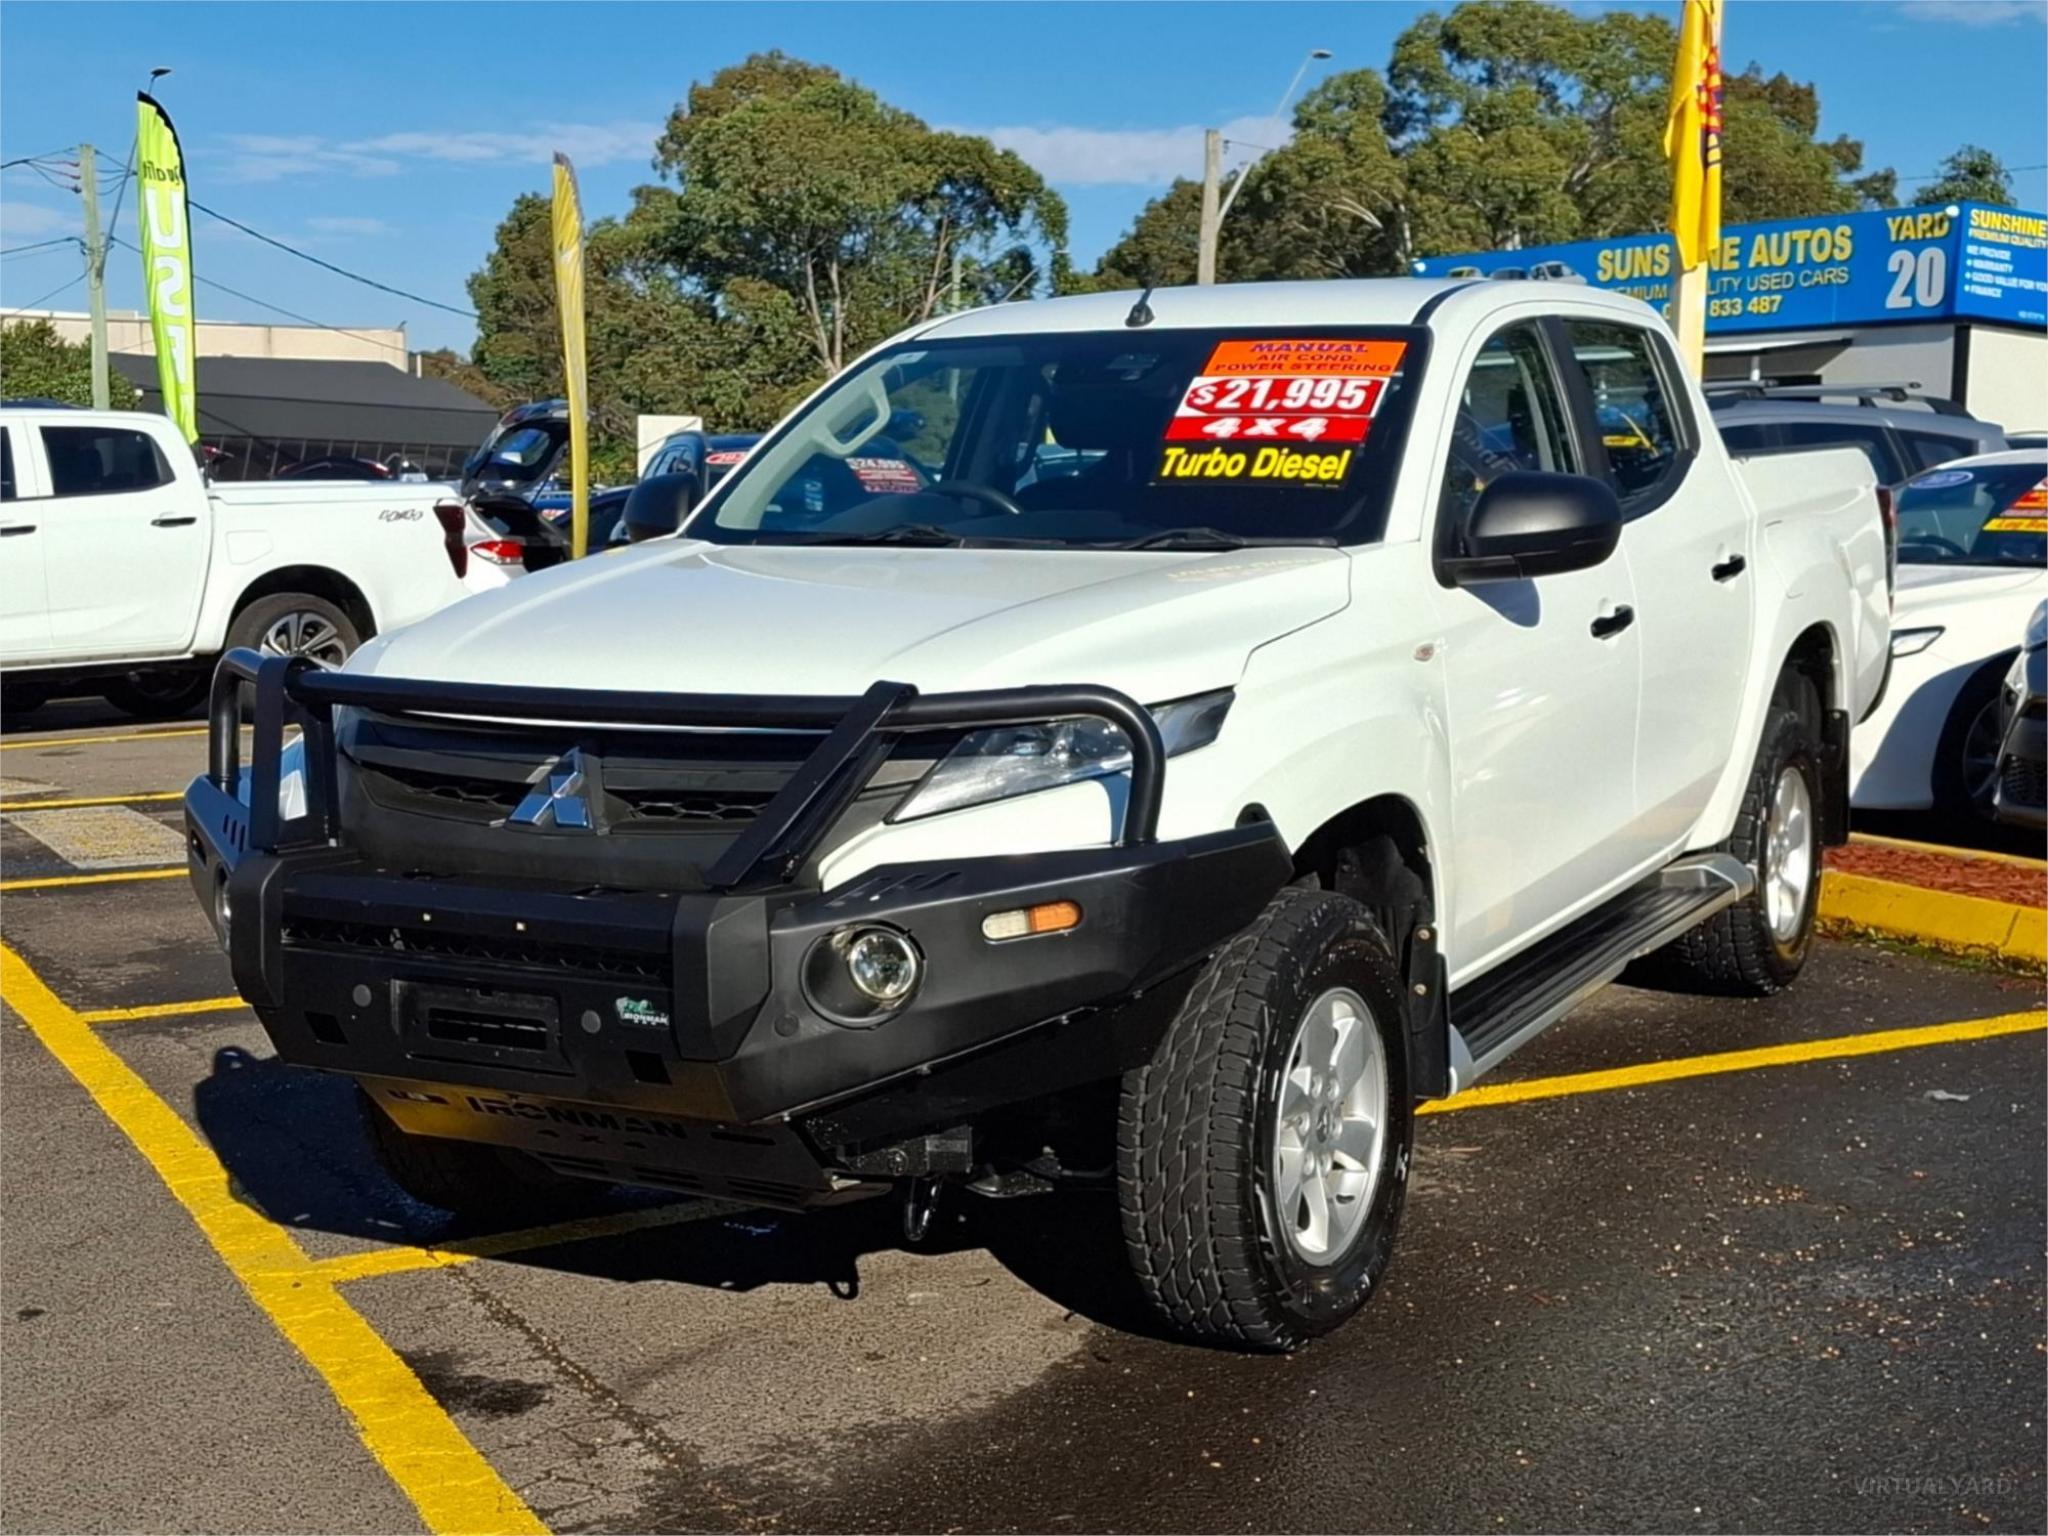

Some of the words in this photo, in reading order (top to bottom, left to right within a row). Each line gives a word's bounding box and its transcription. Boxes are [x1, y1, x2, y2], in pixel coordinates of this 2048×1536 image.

[1886, 213, 1949, 242] YARD
[1970, 209, 2047, 238] SUNSHINE
[1597, 236, 1740, 282] SUNSNE
[1748, 225, 1853, 268] AUTOS
[1746, 272, 1794, 292] USED
[1799, 266, 1849, 288] CARS
[1885, 247, 1946, 309] 20
[1709, 298, 1743, 317] 833
[1747, 295, 1783, 314] 487
[1250, 343, 1369, 353] MANUAL
[1257, 354, 1291, 362] AIR
[1214, 363, 1286, 372] POWER
[1290, 362, 1392, 372] STEERING
[1191, 379, 1372, 411] $21,995
[1161, 446, 1246, 478] Turbo
[1250, 448, 1352, 481] Diesel
